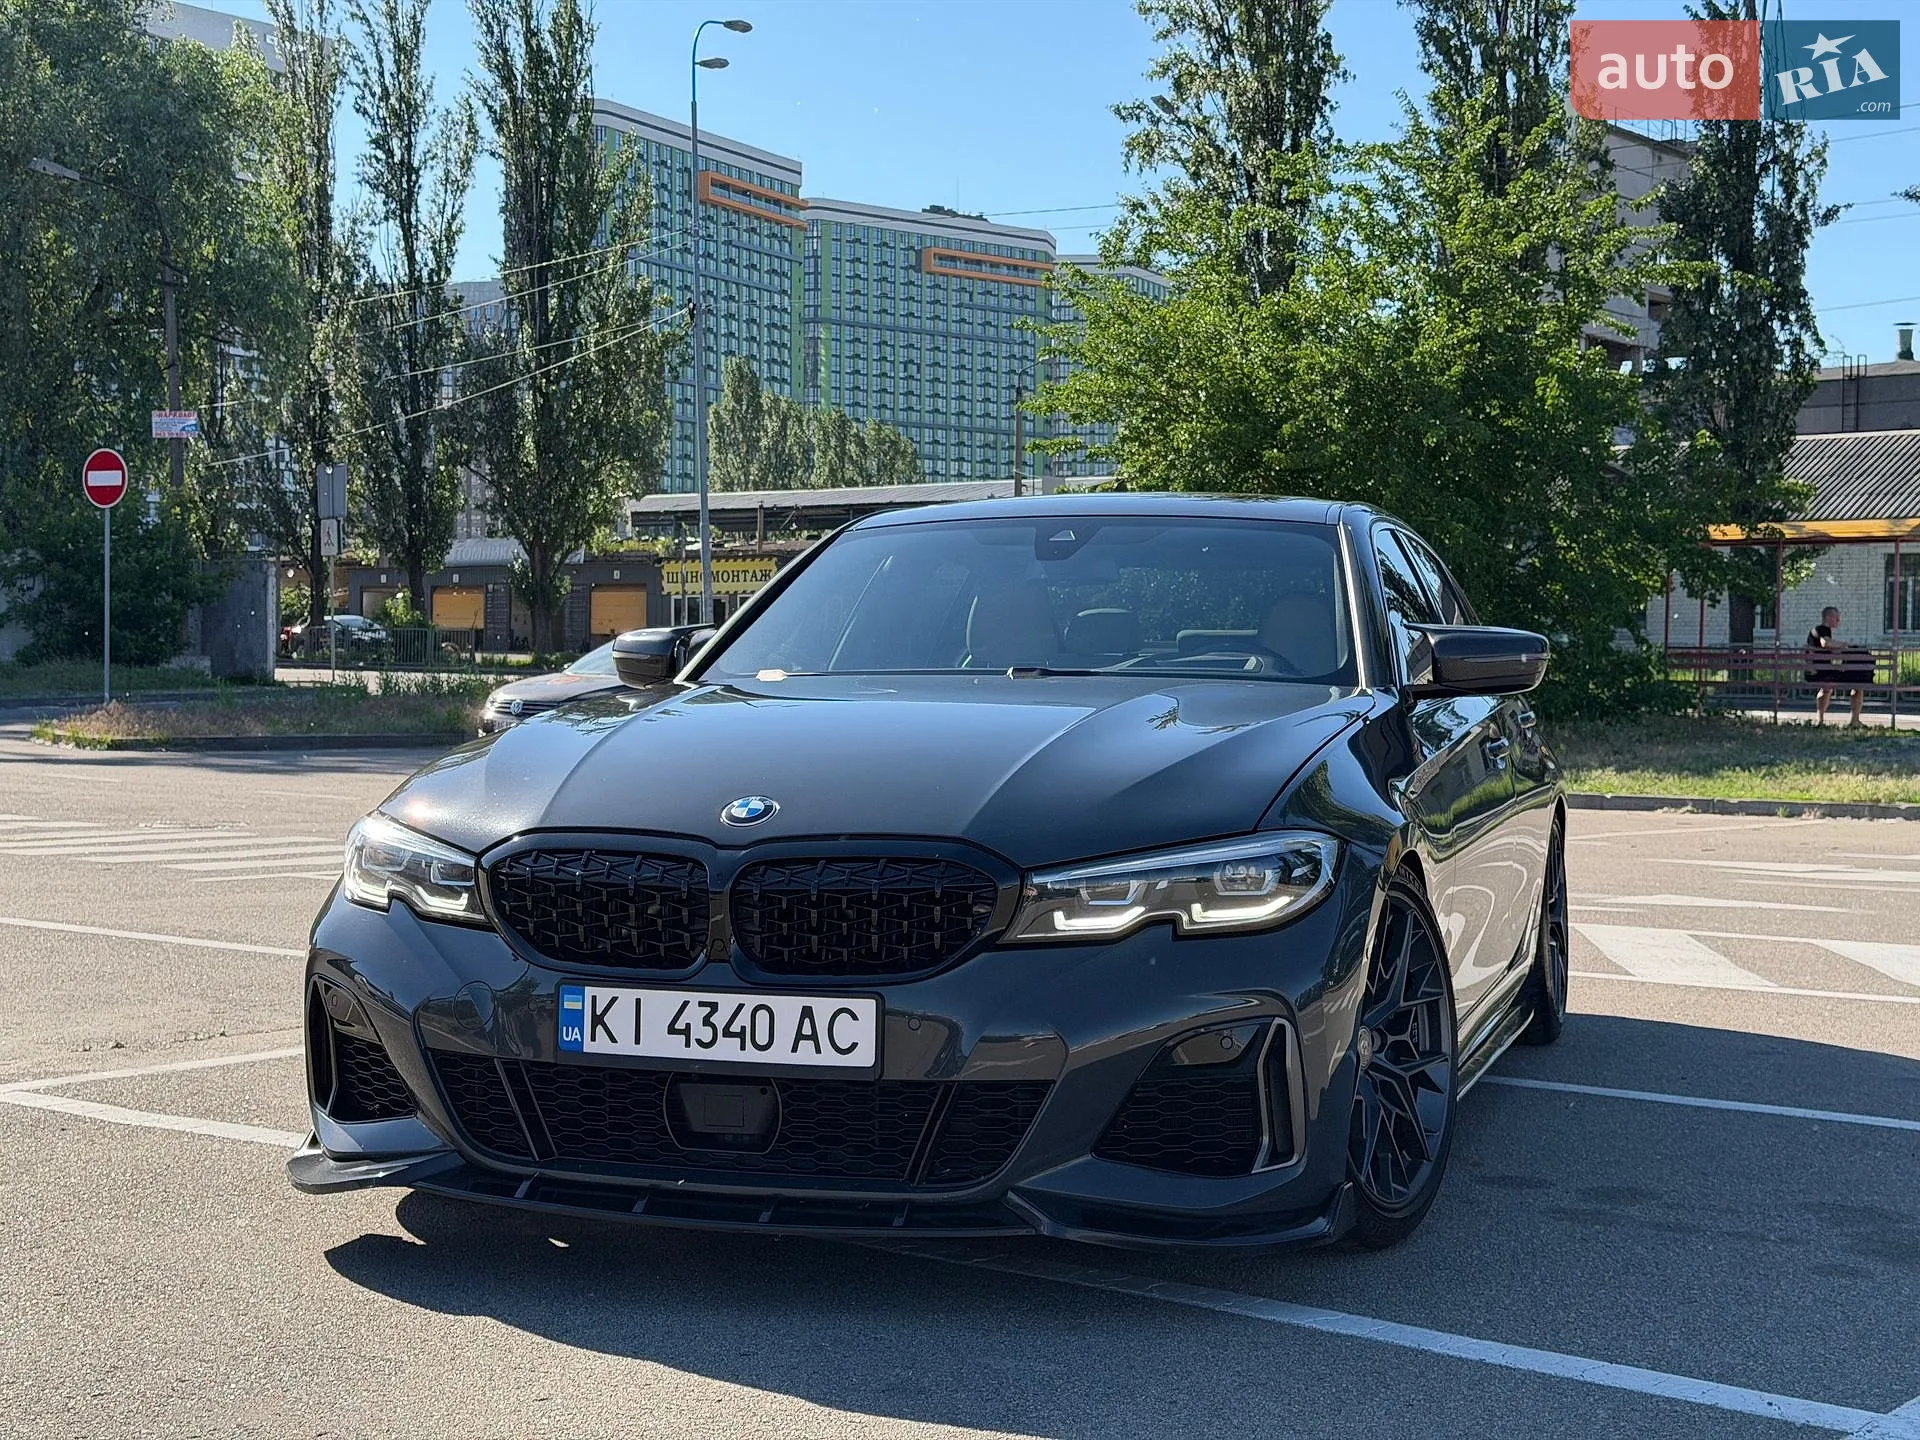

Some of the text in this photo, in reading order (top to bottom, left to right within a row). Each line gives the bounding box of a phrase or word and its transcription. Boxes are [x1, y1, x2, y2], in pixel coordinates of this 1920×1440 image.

[666, 569, 772, 584] ШНМОНТАЖ
[590, 995, 859, 1055] KI 4340 AC
[562, 1026, 582, 1042] UA
